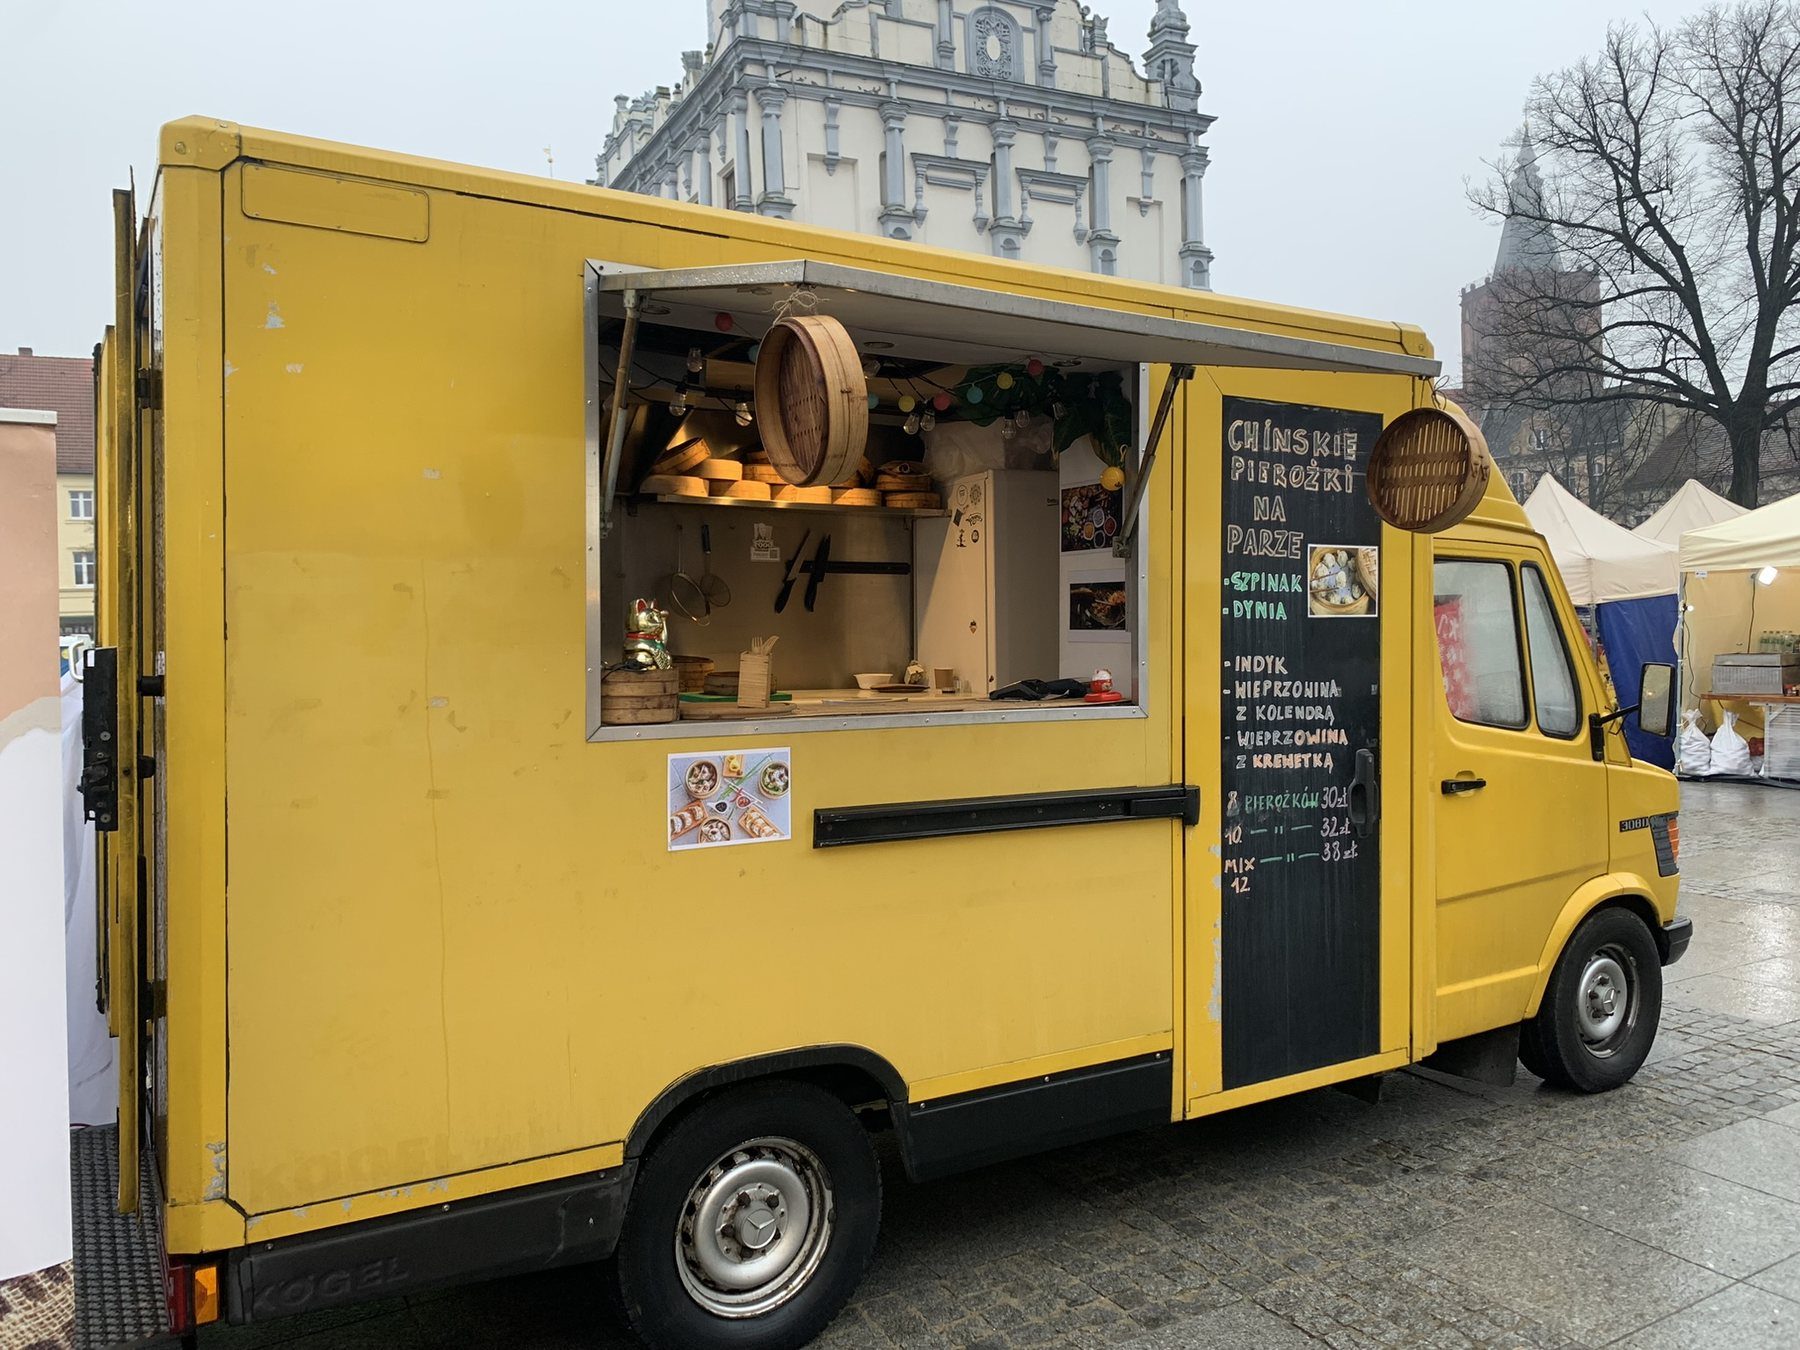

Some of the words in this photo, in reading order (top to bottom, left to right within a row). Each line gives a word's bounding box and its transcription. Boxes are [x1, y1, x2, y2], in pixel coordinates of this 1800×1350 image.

[1253, 496, 1287, 522] NA
[1227, 524, 1304, 560] PARZE
[1236, 705, 1247, 721] Z
[1255, 704, 1335, 726] KOLENDRĄ
[1236, 755, 1247, 769] Z
[1252, 752, 1334, 774] KREWETKĄ
[1227, 790, 1240, 815] 8
[1224, 857, 1256, 873] MIX
[1231, 876, 1251, 894] 12
